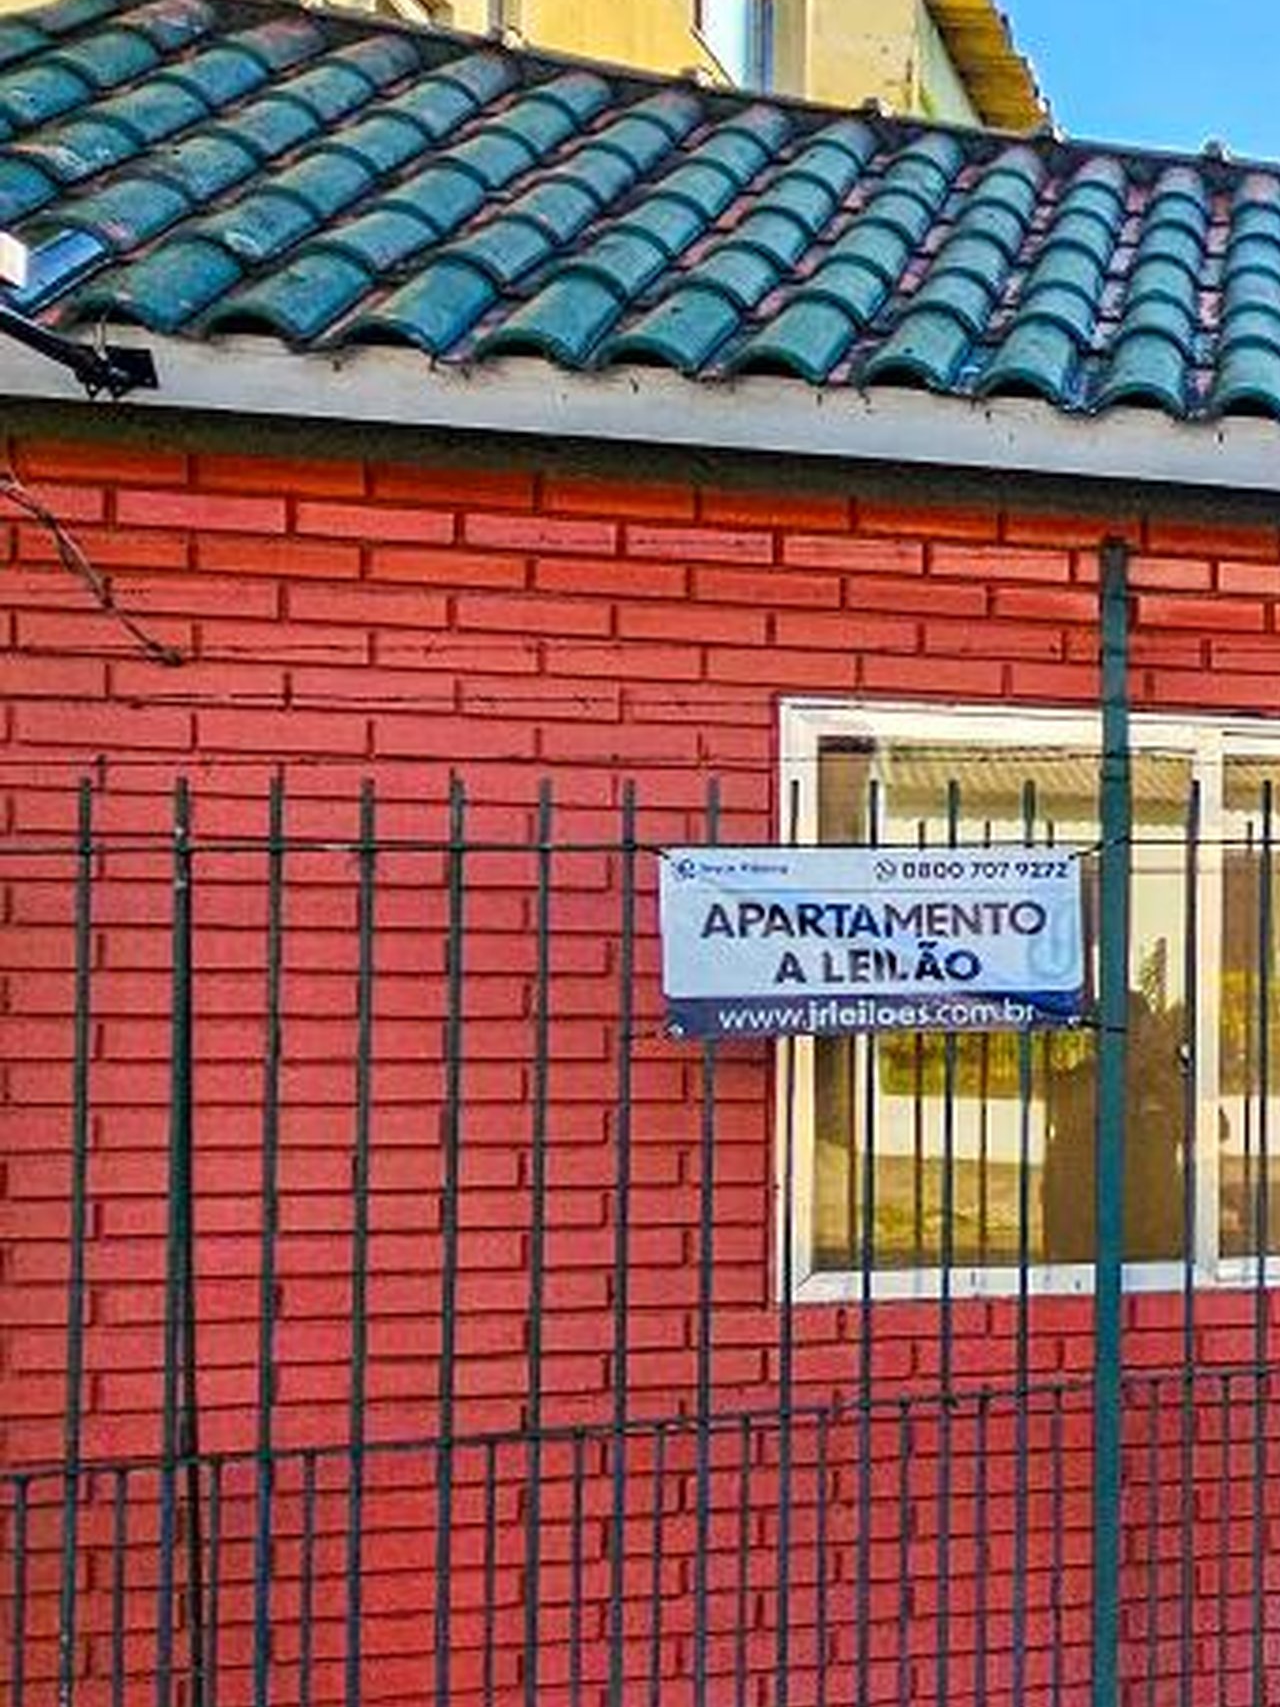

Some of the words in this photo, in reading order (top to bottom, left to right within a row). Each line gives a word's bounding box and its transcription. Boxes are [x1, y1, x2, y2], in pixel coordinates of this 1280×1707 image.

[902, 861, 964, 880] 0800
[970, 861, 1010, 880] 707
[1017, 860, 1069, 879] 9272
[700, 901, 1046, 939] APARTAMENTO
[775, 951, 807, 984] A
[822, 941, 982, 983] LEILÃO
[718, 998, 1037, 1032] www.jrleiloes.com.br
